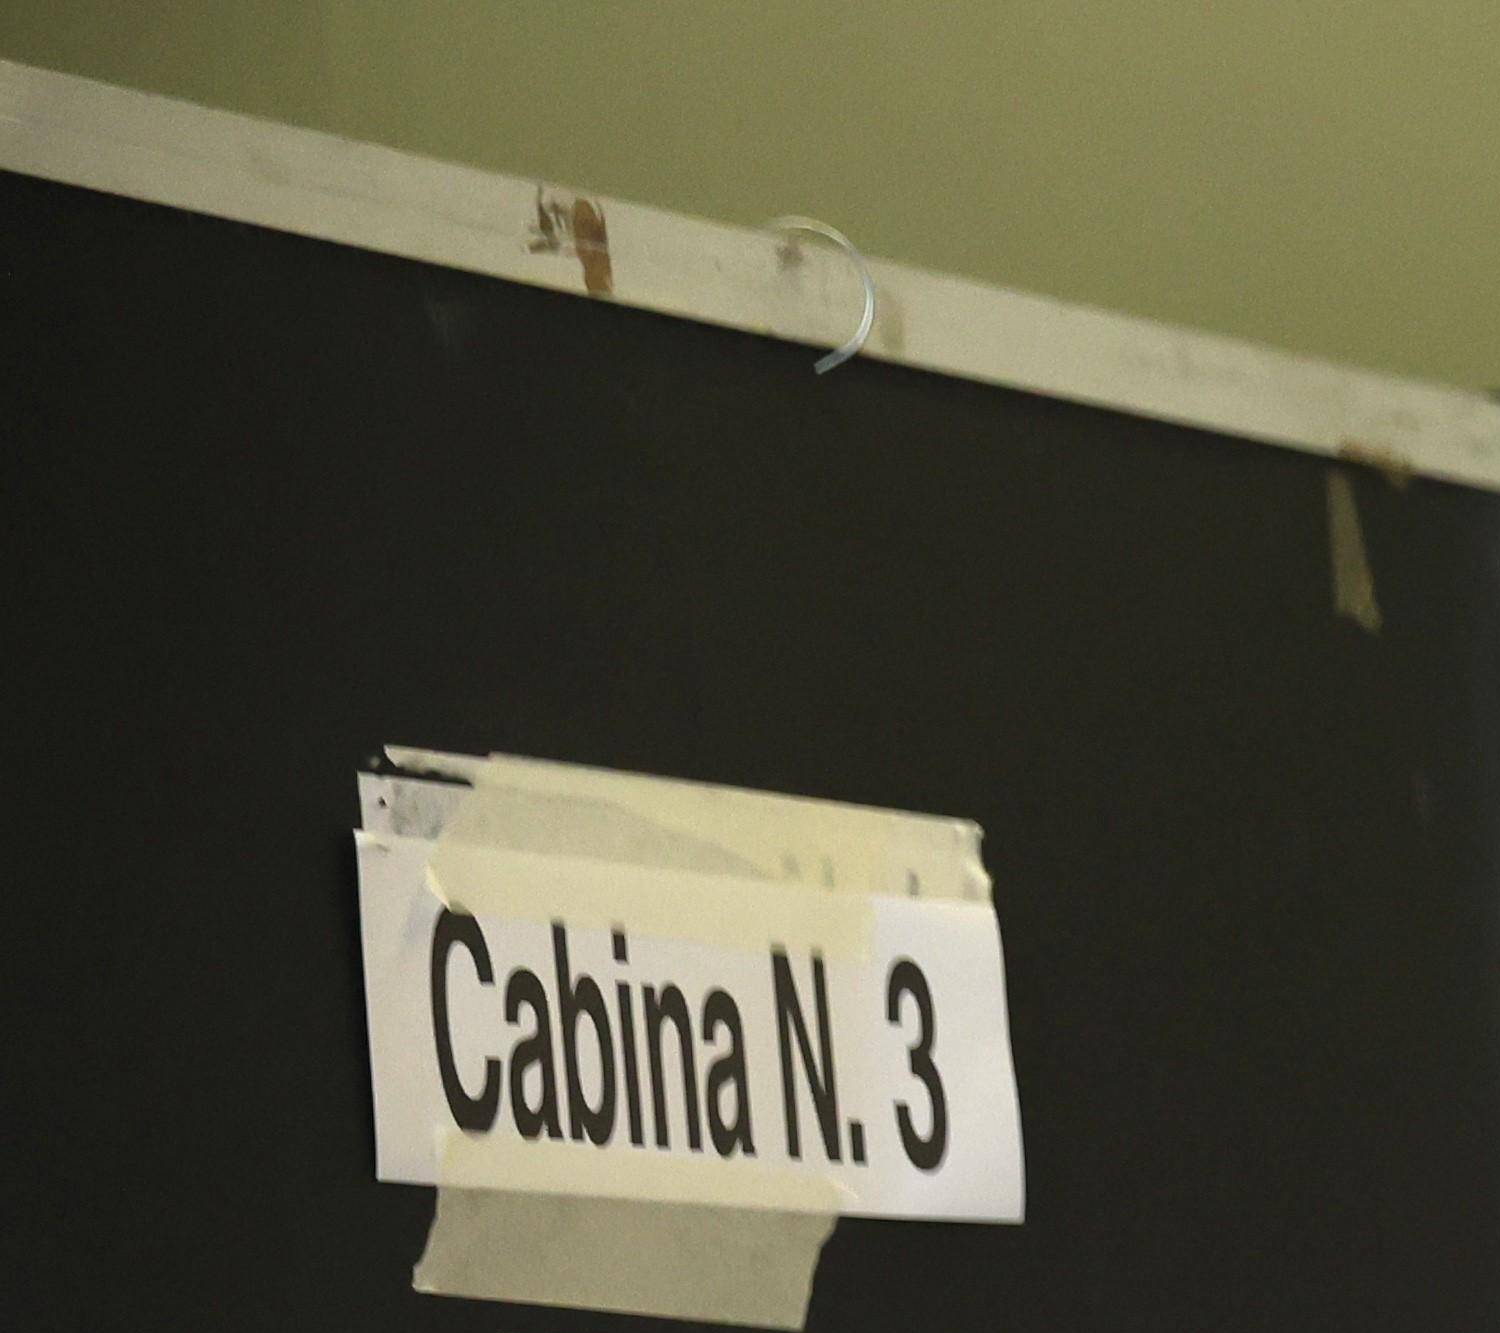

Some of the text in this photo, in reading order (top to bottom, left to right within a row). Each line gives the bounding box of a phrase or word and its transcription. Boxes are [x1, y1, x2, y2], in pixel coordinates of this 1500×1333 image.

[432, 905, 948, 1173] Cabina N. 3
